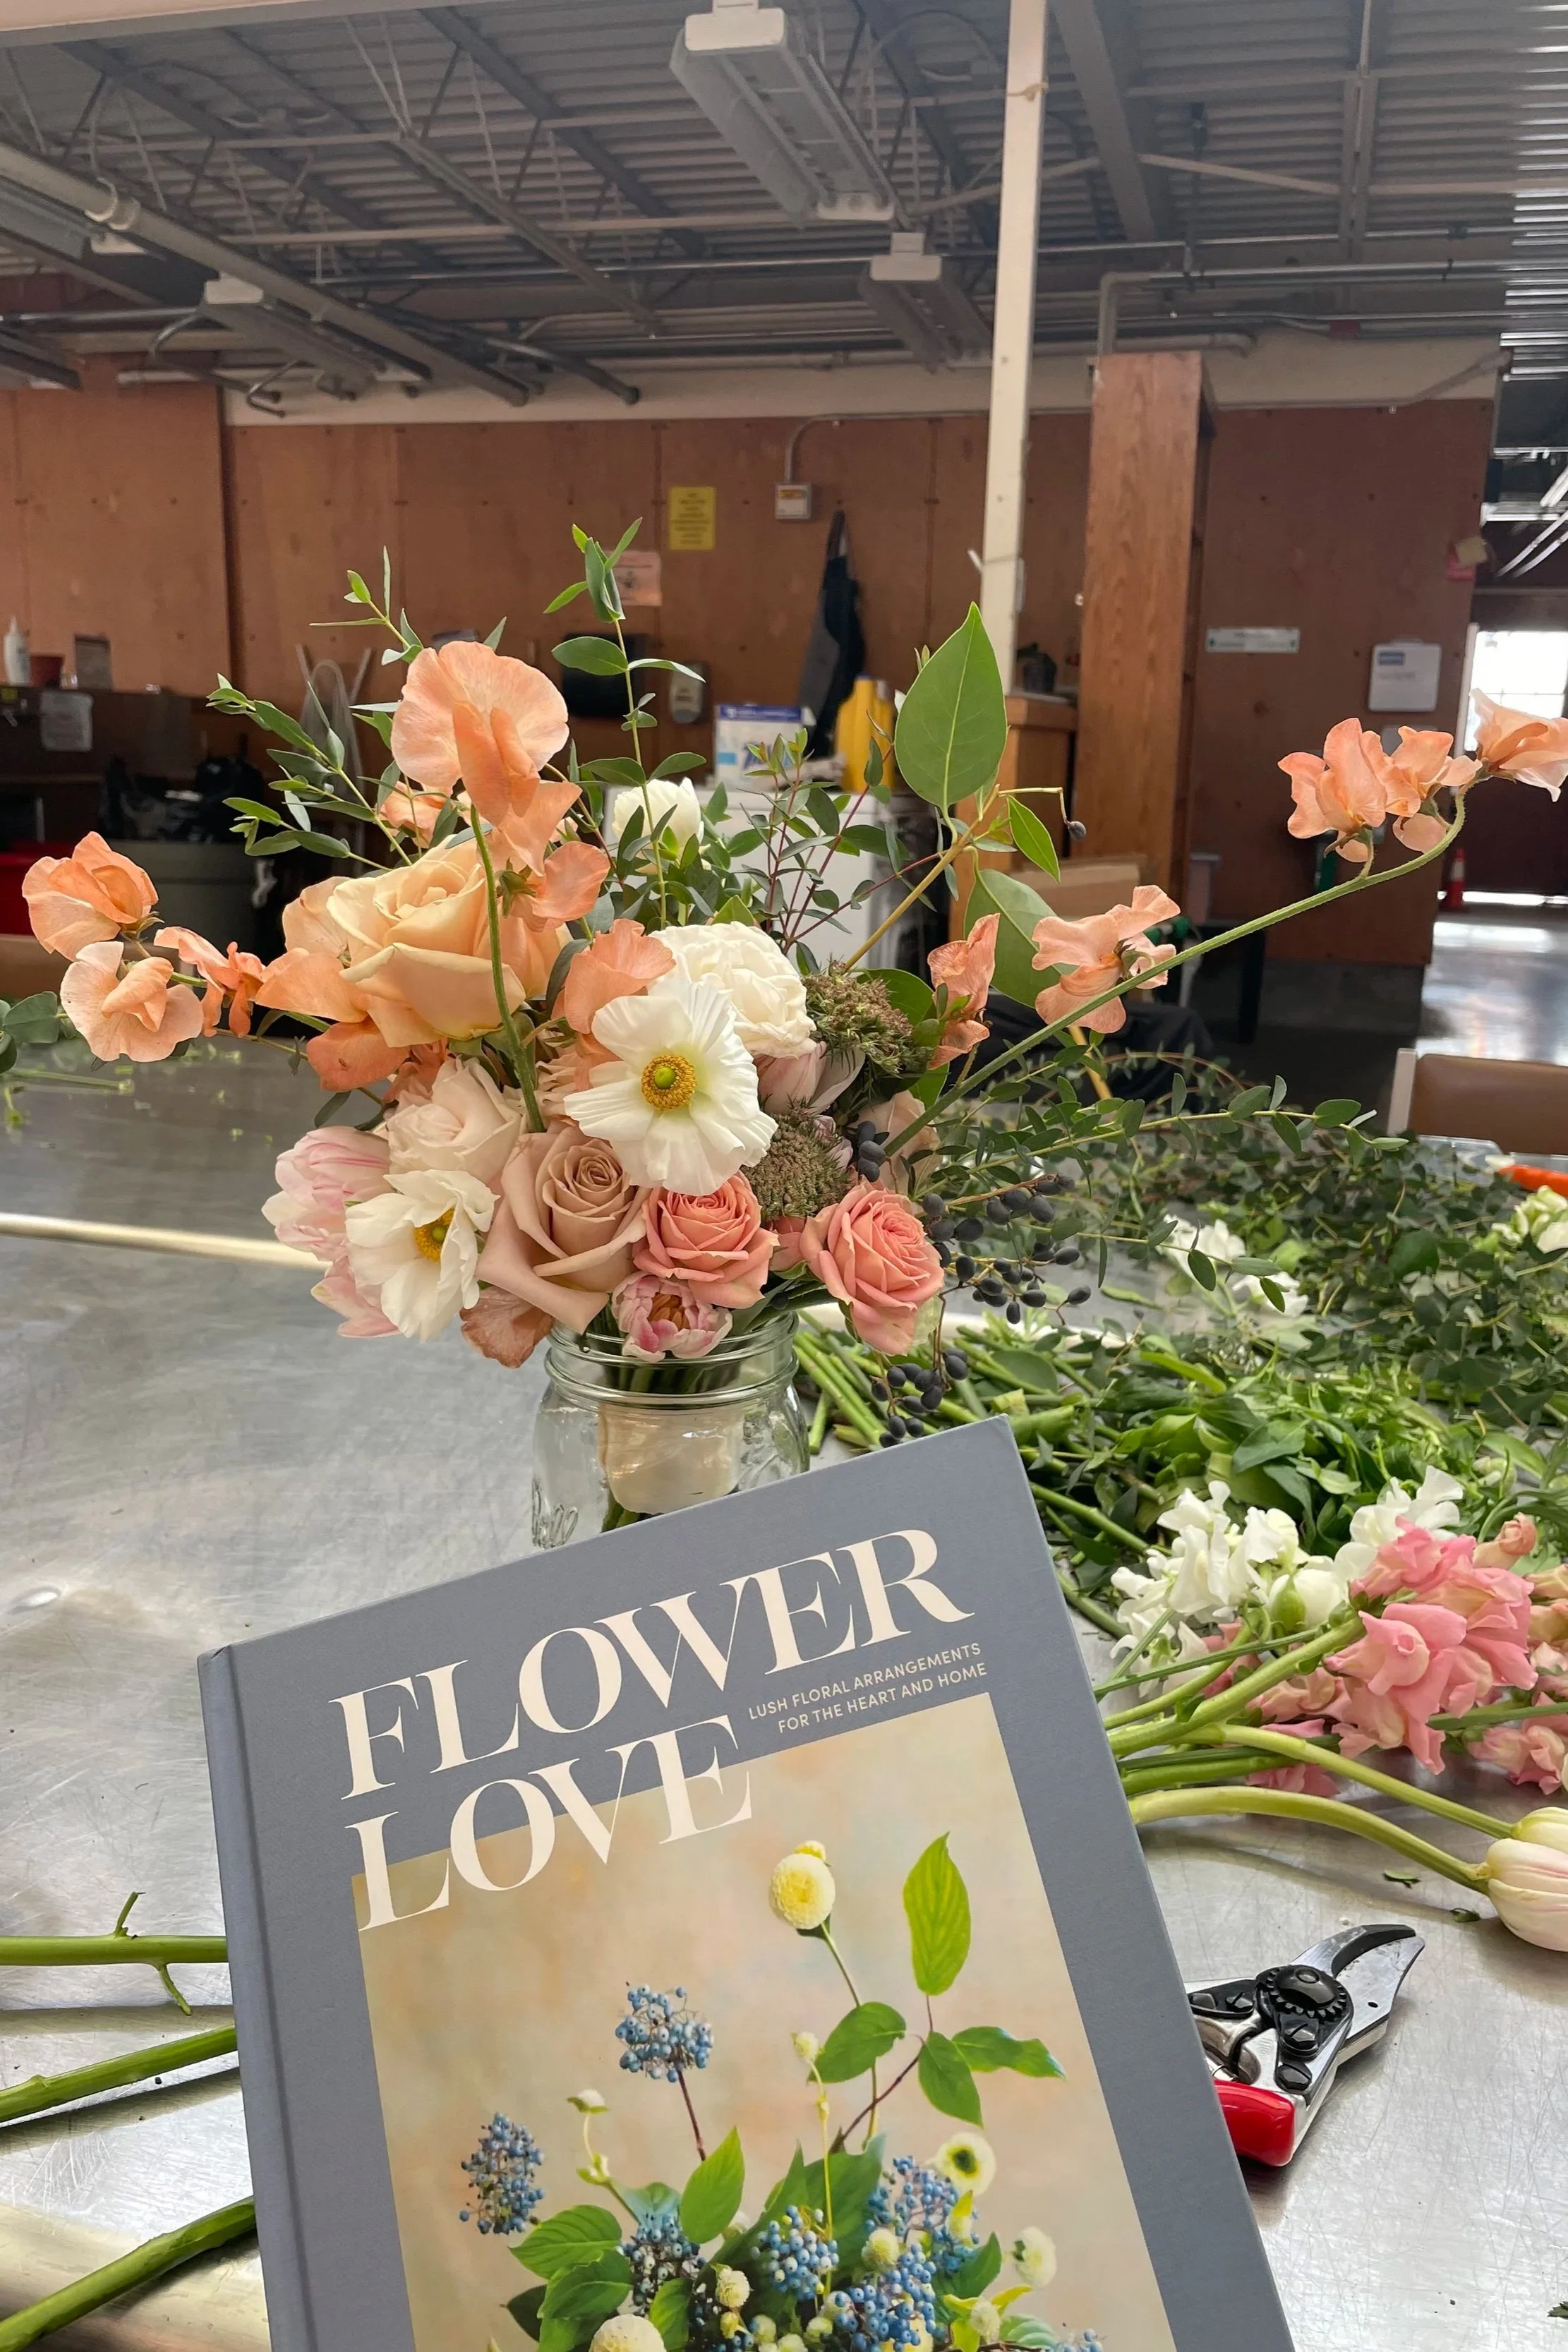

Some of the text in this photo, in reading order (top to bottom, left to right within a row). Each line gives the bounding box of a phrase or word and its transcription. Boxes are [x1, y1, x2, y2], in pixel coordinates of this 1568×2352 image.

[329, 1528, 975, 1800] FLOWER
[749, 1642, 982, 1720] LUSH FLORAL ARRANGEMENTS
[778, 1663, 987, 1733] FOR THE HEART AND HOME
[344, 1714, 752, 1932] LOVE
